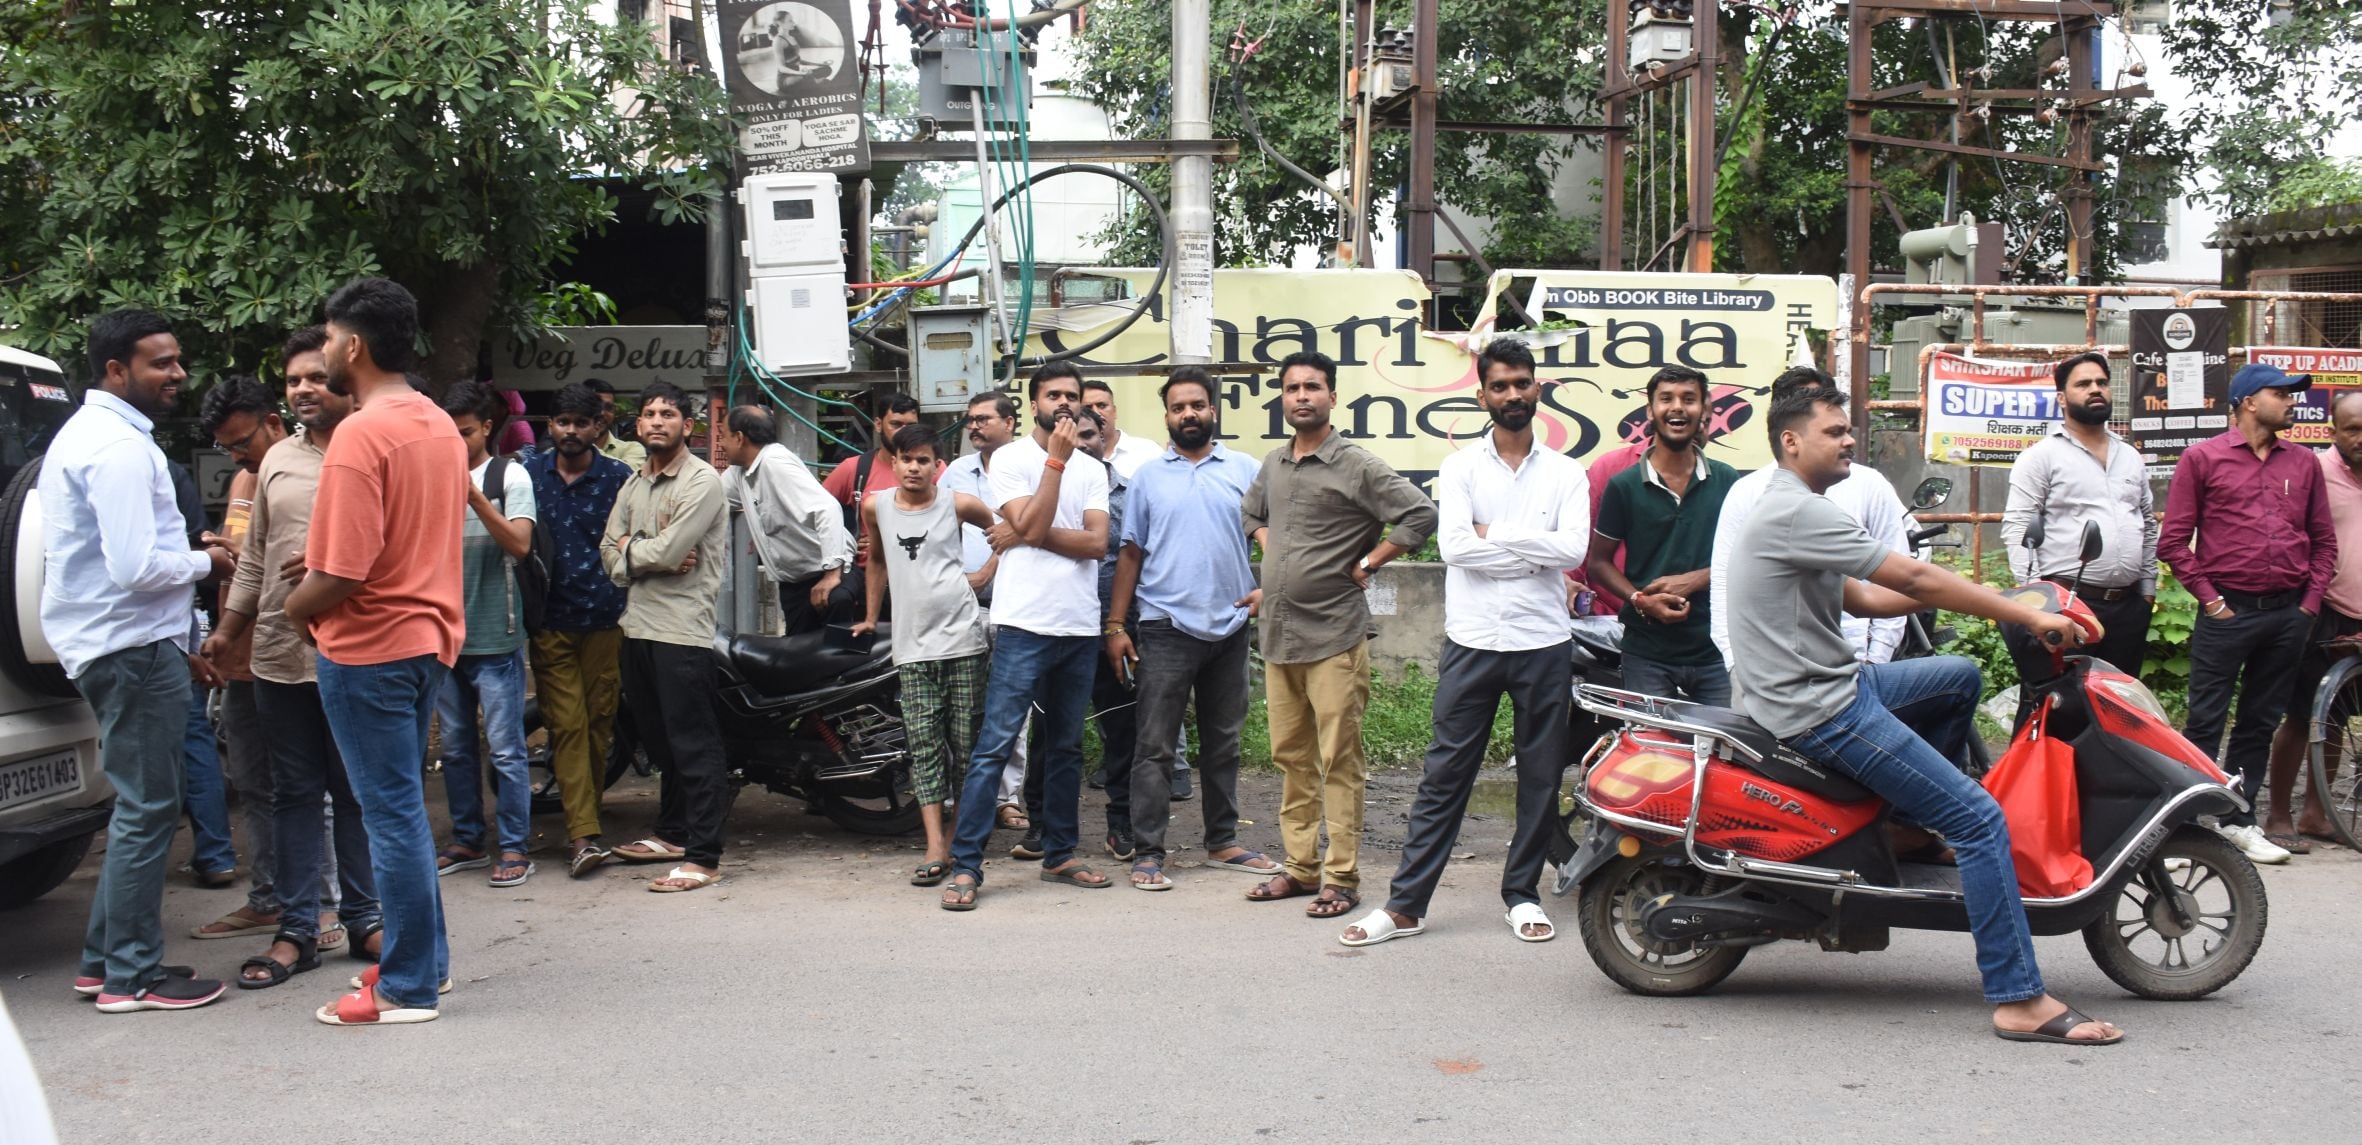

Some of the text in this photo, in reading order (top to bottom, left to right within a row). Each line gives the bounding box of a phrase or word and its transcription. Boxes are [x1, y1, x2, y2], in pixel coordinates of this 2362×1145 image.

[737, 102, 774, 113] YOGA
[792, 92, 857, 108] AEROBICS
[752, 106, 843, 123] ONLY FOR LADIES
[751, 124, 789, 135] 50% OFF
[804, 121, 828, 130] YOGA
[829, 120, 839, 128] SE
[754, 140, 788, 149] MONTH
[760, 132, 781, 141] THIS
[747, 153, 768, 162] NEAR
[822, 143, 858, 153] HOSPITAL
[1564, 290, 1600, 304] Obb
[1605, 290, 1659, 305] BOOK
[1664, 291, 1698, 305] Bite
[1703, 292, 1763, 308] Library
[507, 338, 578, 380] Veg
[2133, 352, 2163, 366] Cafe
[2257, 353, 2292, 371] STEP
[2295, 355, 2316, 371] UP
[2031, 364, 2055, 377] MA
[2325, 375, 2358, 384] INSTITUTE
[32, 385, 69, 401] POLICE
[1945, 386, 2064, 418] SUPER T
[1987, 420, 2049, 436] शिक्षक भर्ती
[1971, 450, 2020, 461] Kapoorth
[1741, 781, 1781, 807] HERO
